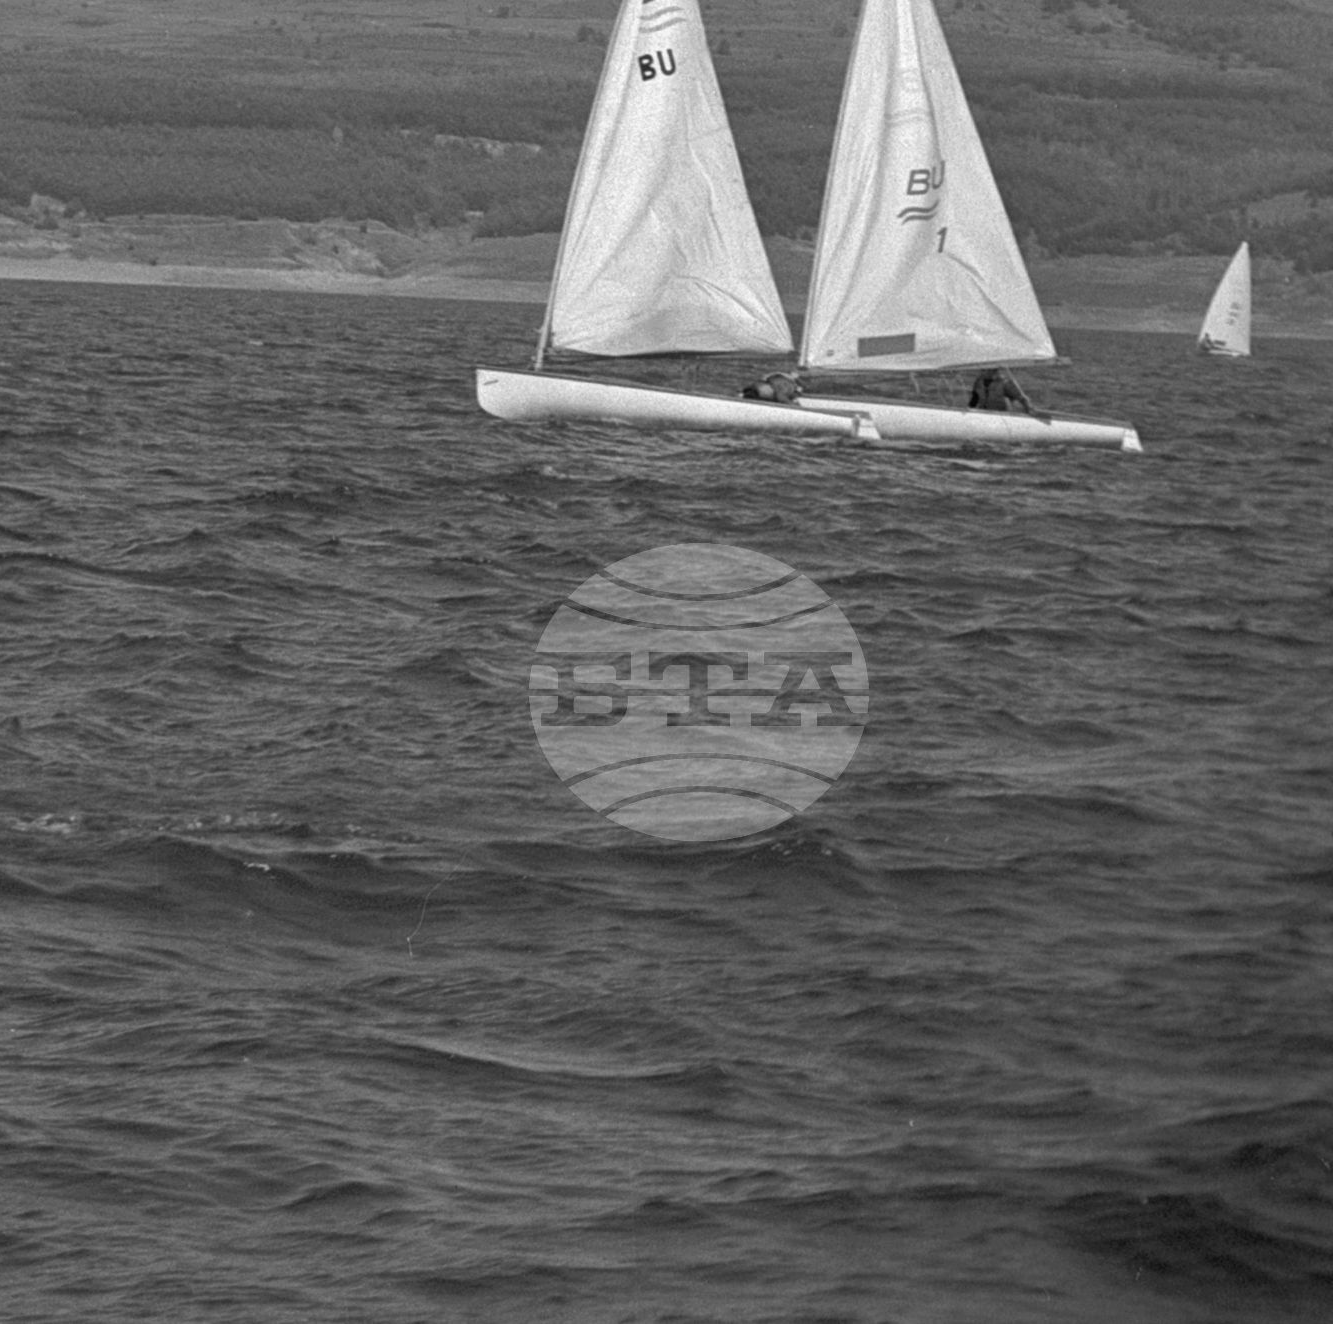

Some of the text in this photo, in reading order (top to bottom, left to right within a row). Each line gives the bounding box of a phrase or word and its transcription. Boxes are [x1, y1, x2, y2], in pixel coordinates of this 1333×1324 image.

[638, 48, 676, 81] BU
[906, 160, 946, 195] BU
[936, 227, 948, 253] 1
